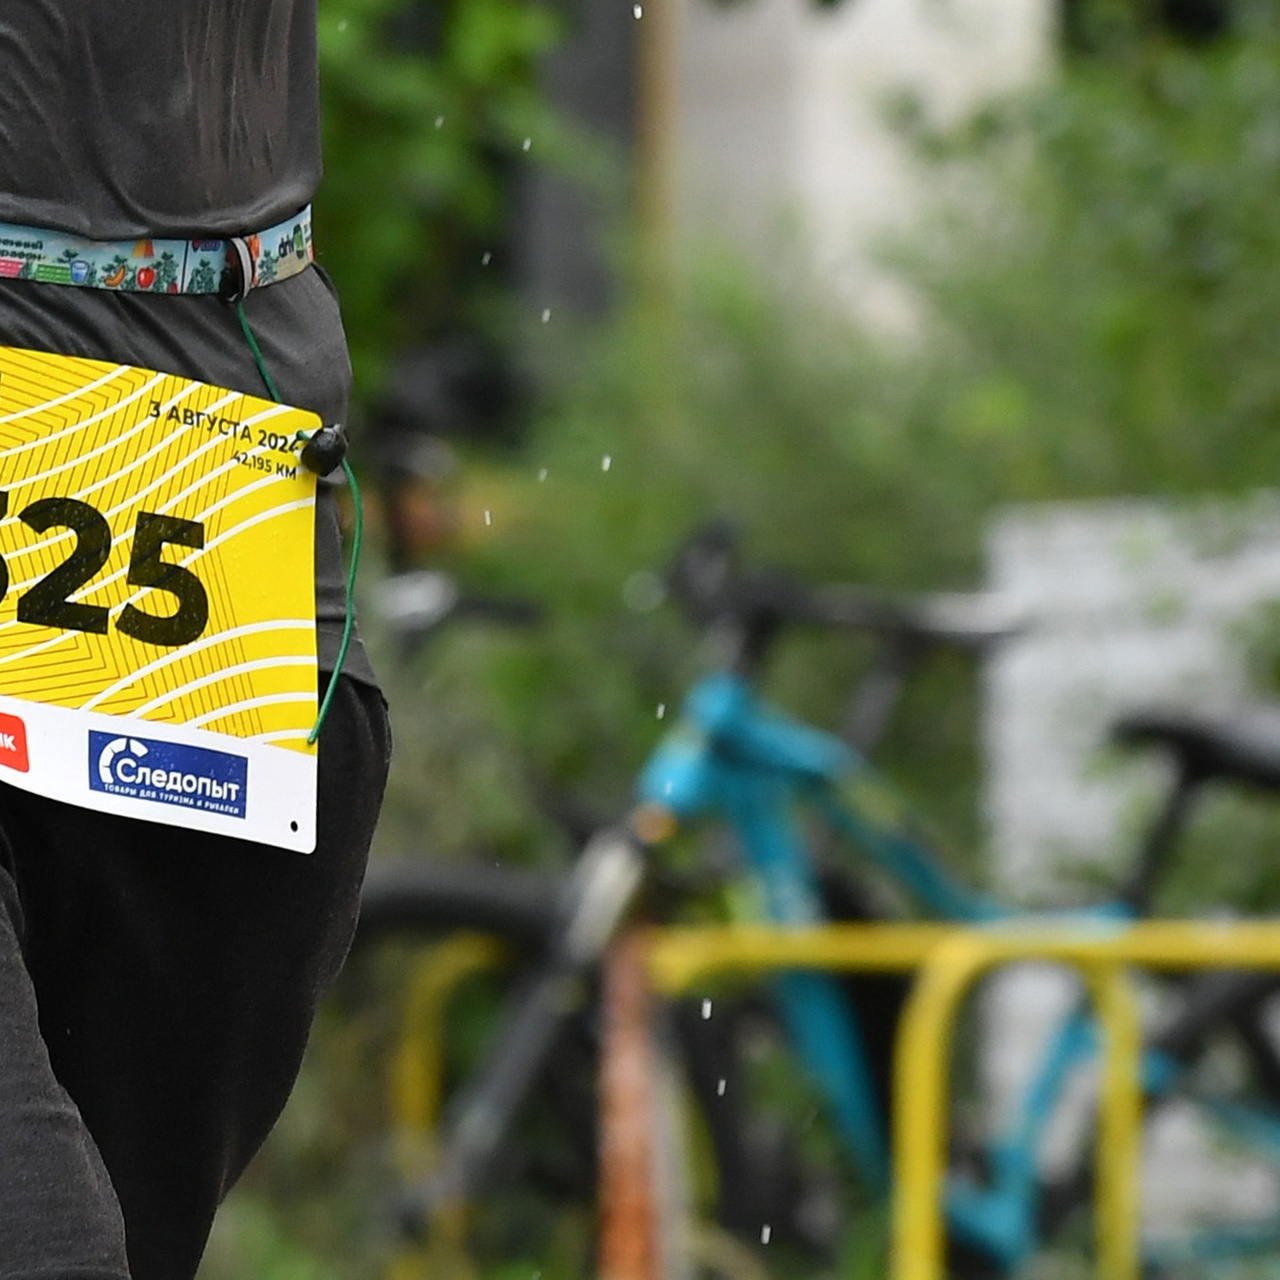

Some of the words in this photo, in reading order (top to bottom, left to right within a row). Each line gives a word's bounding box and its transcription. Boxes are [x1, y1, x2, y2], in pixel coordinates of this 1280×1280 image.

[150, 401, 160, 418] 3
[167, 407, 252, 444] АВГУСТА
[233, 450, 272, 473] 42,195
[276, 462, 296, 481] КМ
[104, 784, 137, 796] ТОВАРЫ
[160, 792, 195, 806] ТУРИЗМА
[116, 757, 240, 802] Следопыт
